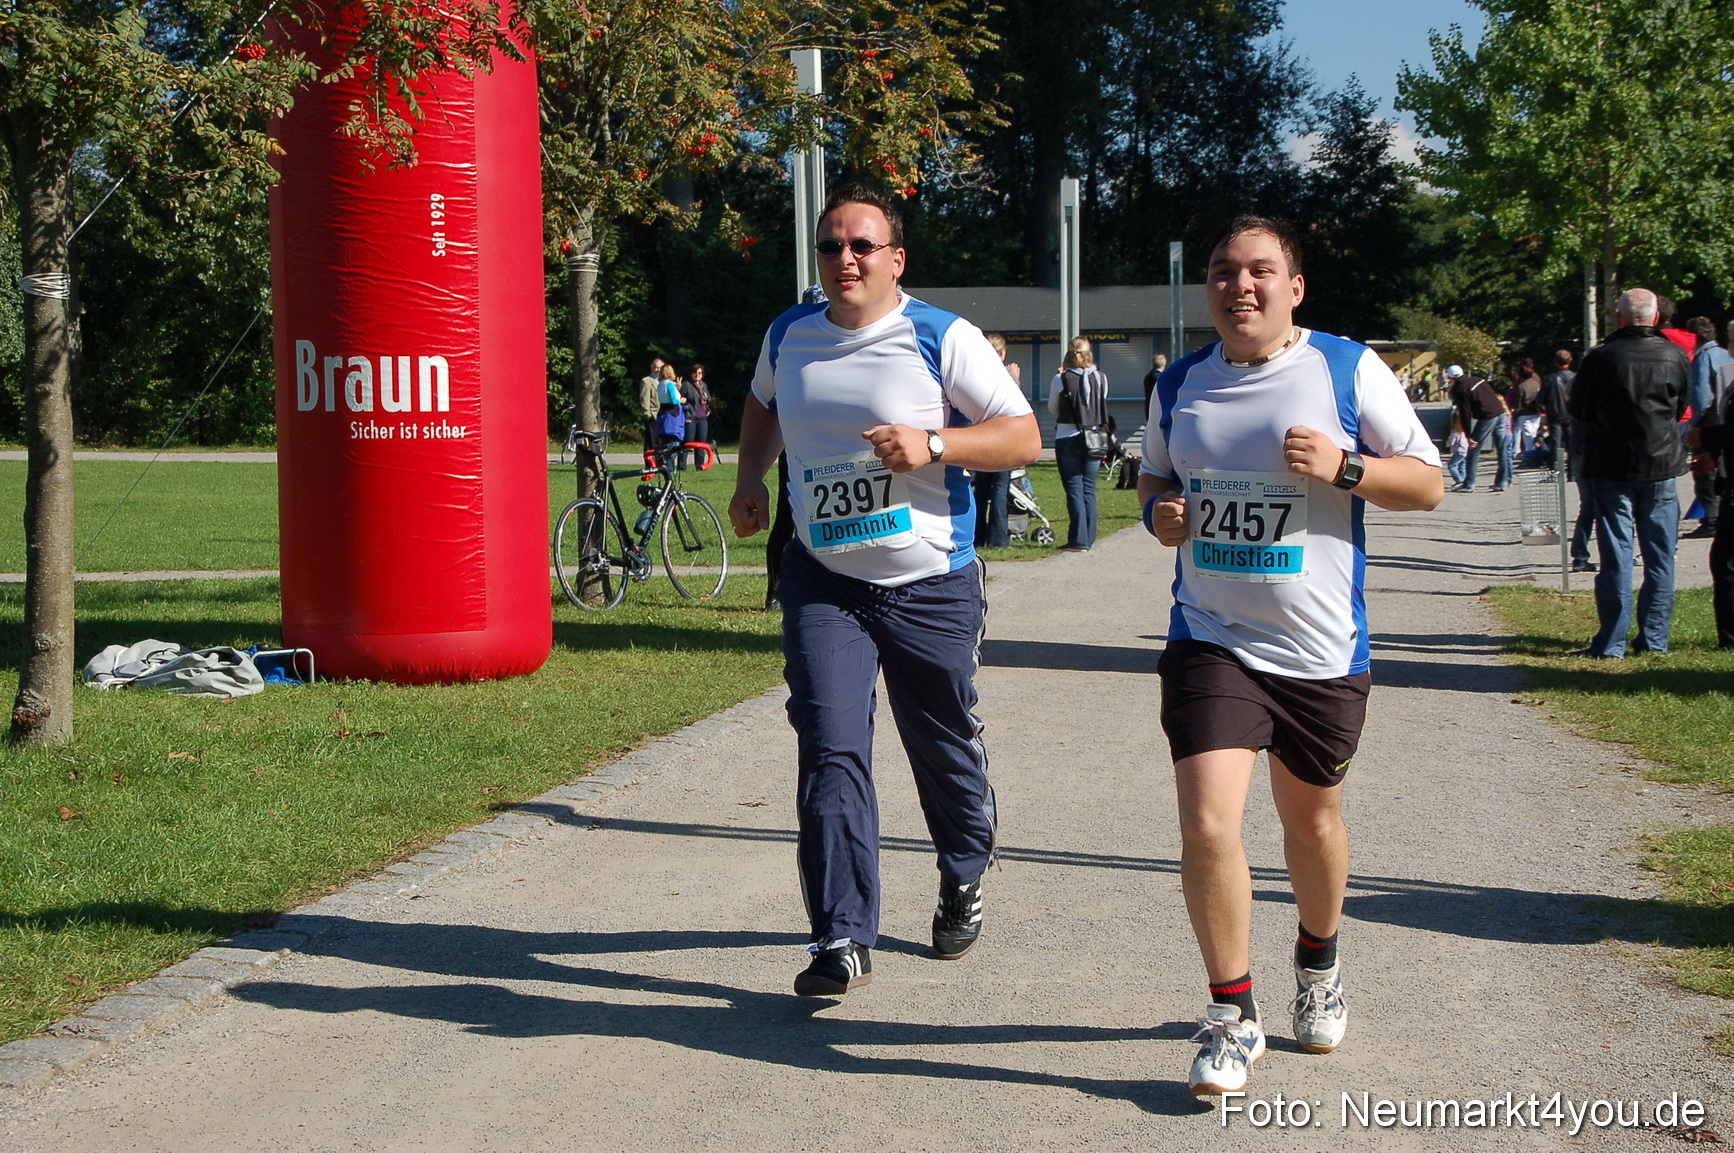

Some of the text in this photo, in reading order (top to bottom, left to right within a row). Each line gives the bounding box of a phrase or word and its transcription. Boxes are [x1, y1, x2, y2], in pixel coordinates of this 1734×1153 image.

[430, 193, 446, 257] Seit 1929
[296, 340, 450, 412] Braun
[350, 419, 467, 439] Sicher ist sicher
[813, 462, 856, 476] PFLEIDERER
[813, 474, 893, 519] 2397
[1202, 479, 1251, 492] PFLEIDERER
[821, 513, 898, 542] Dominik
[1200, 498, 1292, 542] 2457
[1202, 542, 1289, 568] Christian
